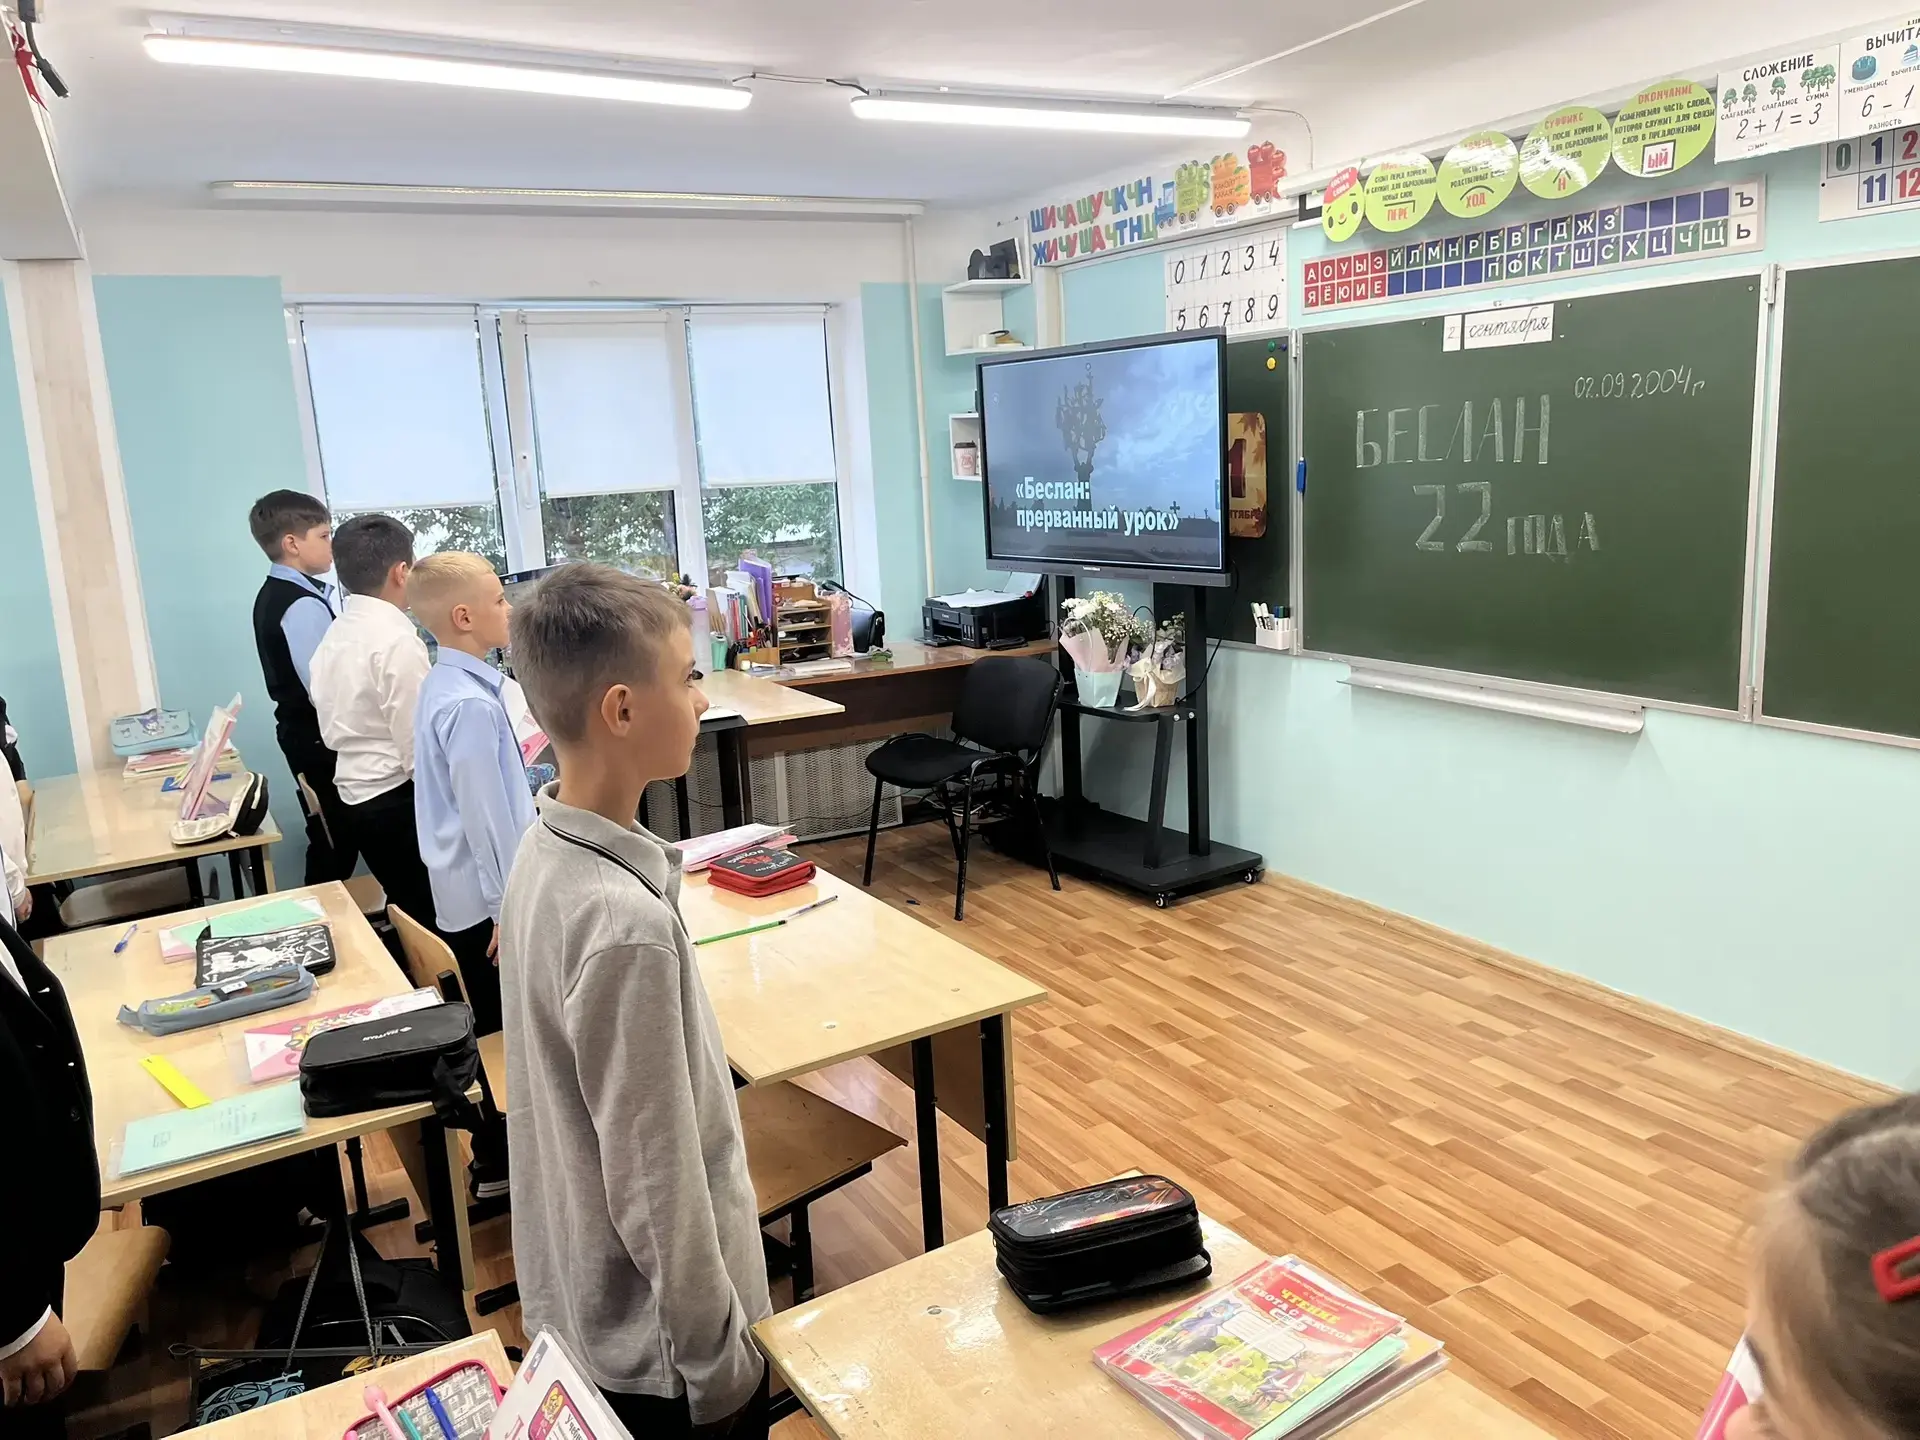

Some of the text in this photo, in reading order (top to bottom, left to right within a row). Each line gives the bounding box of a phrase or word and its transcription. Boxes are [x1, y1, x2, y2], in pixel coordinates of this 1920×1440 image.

[1743, 54, 1814, 82] СЛОЖЕНИЕ
[1638, 84, 1693, 104] ОКОНЧАНИЕ
[1844, 79, 1888, 95] УМЕНЬШАЕМОЕ
[1862, 94, 1875, 118] 6
[1904, 85, 1915, 109] 1
[1545, 112, 1584, 130] СУФФИКС
[1615, 109, 1715, 134] КОТОРАЯ СЛУЖИТ ДЛЯ СВЯЗИ
[1620, 107, 1660, 122] ИЗМЕНЯЕМАЯ
[1664, 102, 1684, 113] ЧАСТЬ
[1720, 91, 1829, 121] СЛАГАЕМОЕ СЛАГАЕМОЕ СУММА
[1736, 118, 1749, 140] 2
[1774, 110, 1784, 132] 1
[1809, 102, 1822, 125] 3
[1622, 135, 1638, 145] СЛОВ
[1641, 133, 1646, 141] В
[1868, 119, 1902, 131] РАЗНОСТЬ
[1648, 148, 1668, 169] ЫЙ
[1836, 129, 1920, 172] 0 1 2
[1558, 176, 1566, 191] Н
[1862, 172, 1887, 204] 11
[1030, 205, 1056, 233] ШИ
[1057, 204, 1077, 229] ЧА
[1076, 191, 1104, 224] ЩУ
[1104, 185, 1128, 215] ЧК
[1127, 176, 1152, 208] ЧН
[1387, 207, 1408, 221] ПЕРЕ
[1466, 192, 1486, 209] ХОД
[1032, 238, 1058, 266] ЖИ
[1059, 233, 1078, 258] ЧУ
[1079, 225, 1106, 254] ША
[1105, 219, 1127, 248] ЧТ
[1307, 192, 1754, 281] А О У Ы Э Й Л М Н Р Б В Г Д Ж З Ъ
[1175, 240, 1279, 285] 0 1 2 3 4
[1307, 291, 1316, 304] Я
[1324, 287, 1332, 302] Ё
[1338, 286, 1350, 299] Ю
[1356, 283, 1366, 297] И
[1374, 281, 1383, 295] Е
[1737, 224, 1751, 239] Ь
[1176, 294, 1279, 332] 5 6 7 8 9
[1447, 306, 1550, 342] 2 сентября
[1356, 394, 1550, 468] БЕСЛАН
[1229, 438, 1246, 498] 1
[1015, 477, 1090, 501] «Беслан:
[1016, 505, 1180, 536] прерванный урок»
[1412, 481, 1493, 553] 22
